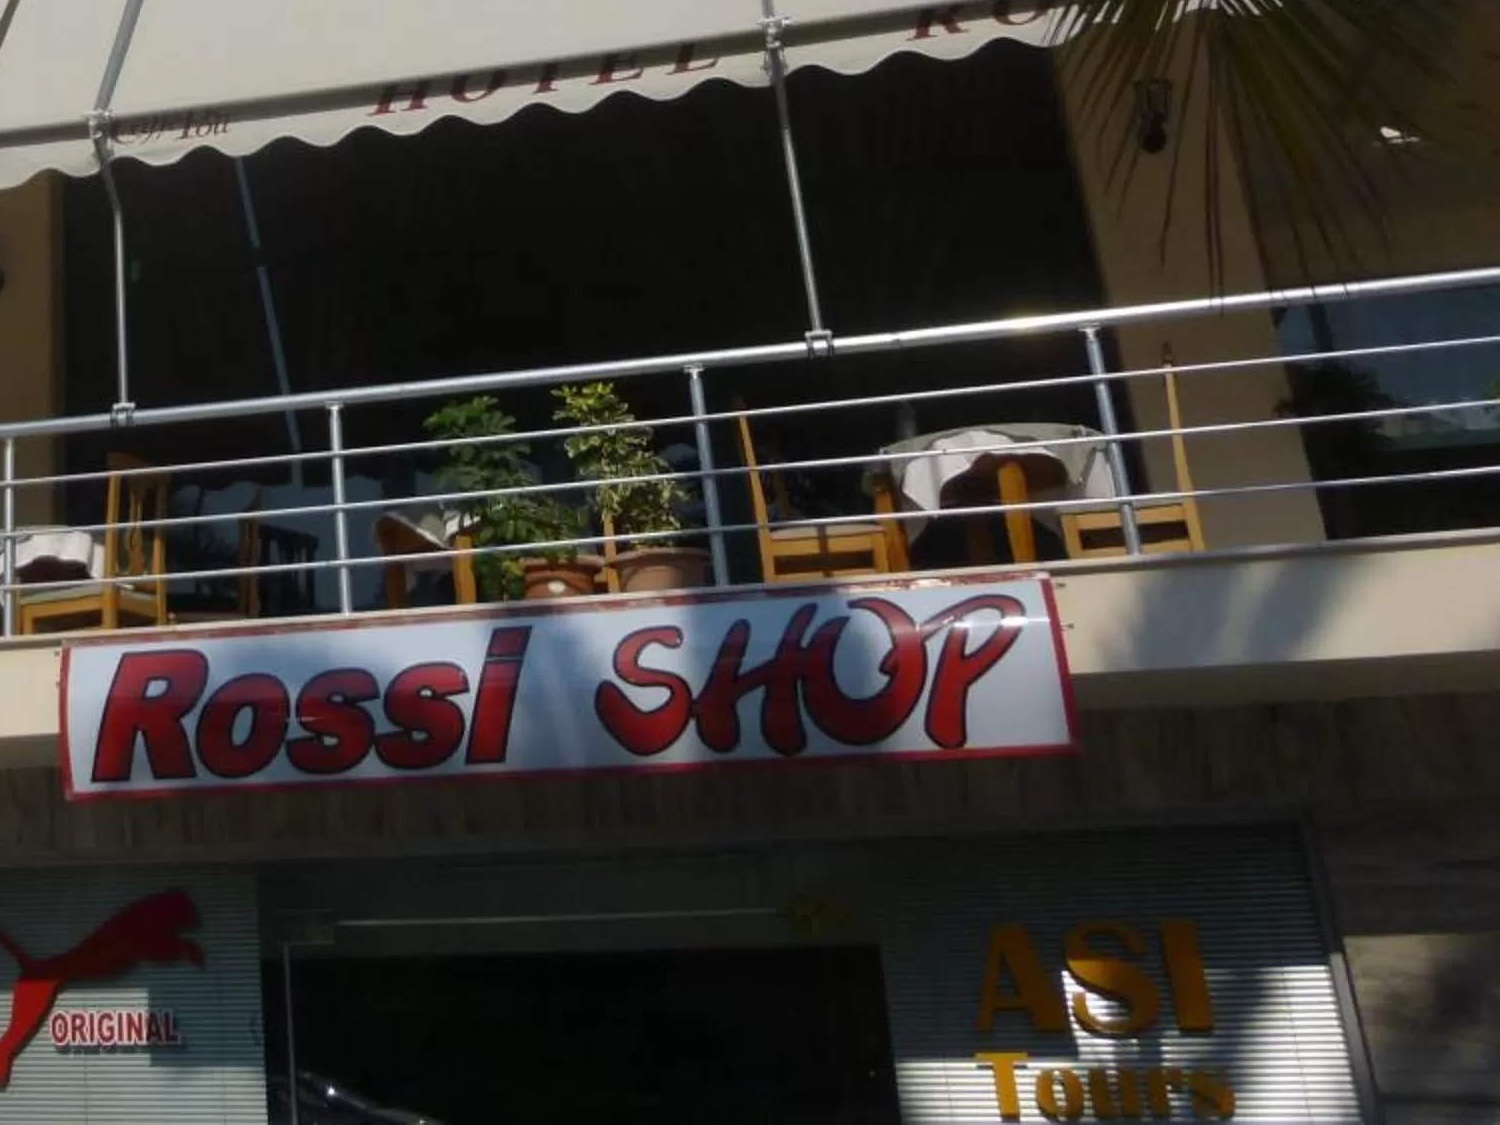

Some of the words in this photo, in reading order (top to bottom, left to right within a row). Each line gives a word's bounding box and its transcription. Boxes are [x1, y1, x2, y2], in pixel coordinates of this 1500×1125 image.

[593, 593, 1028, 757] SHOP
[975, 922, 1217, 1034] ASI
[50, 1011, 181, 1044] ORIGINAL
[973, 1051, 1236, 1124] Tours
